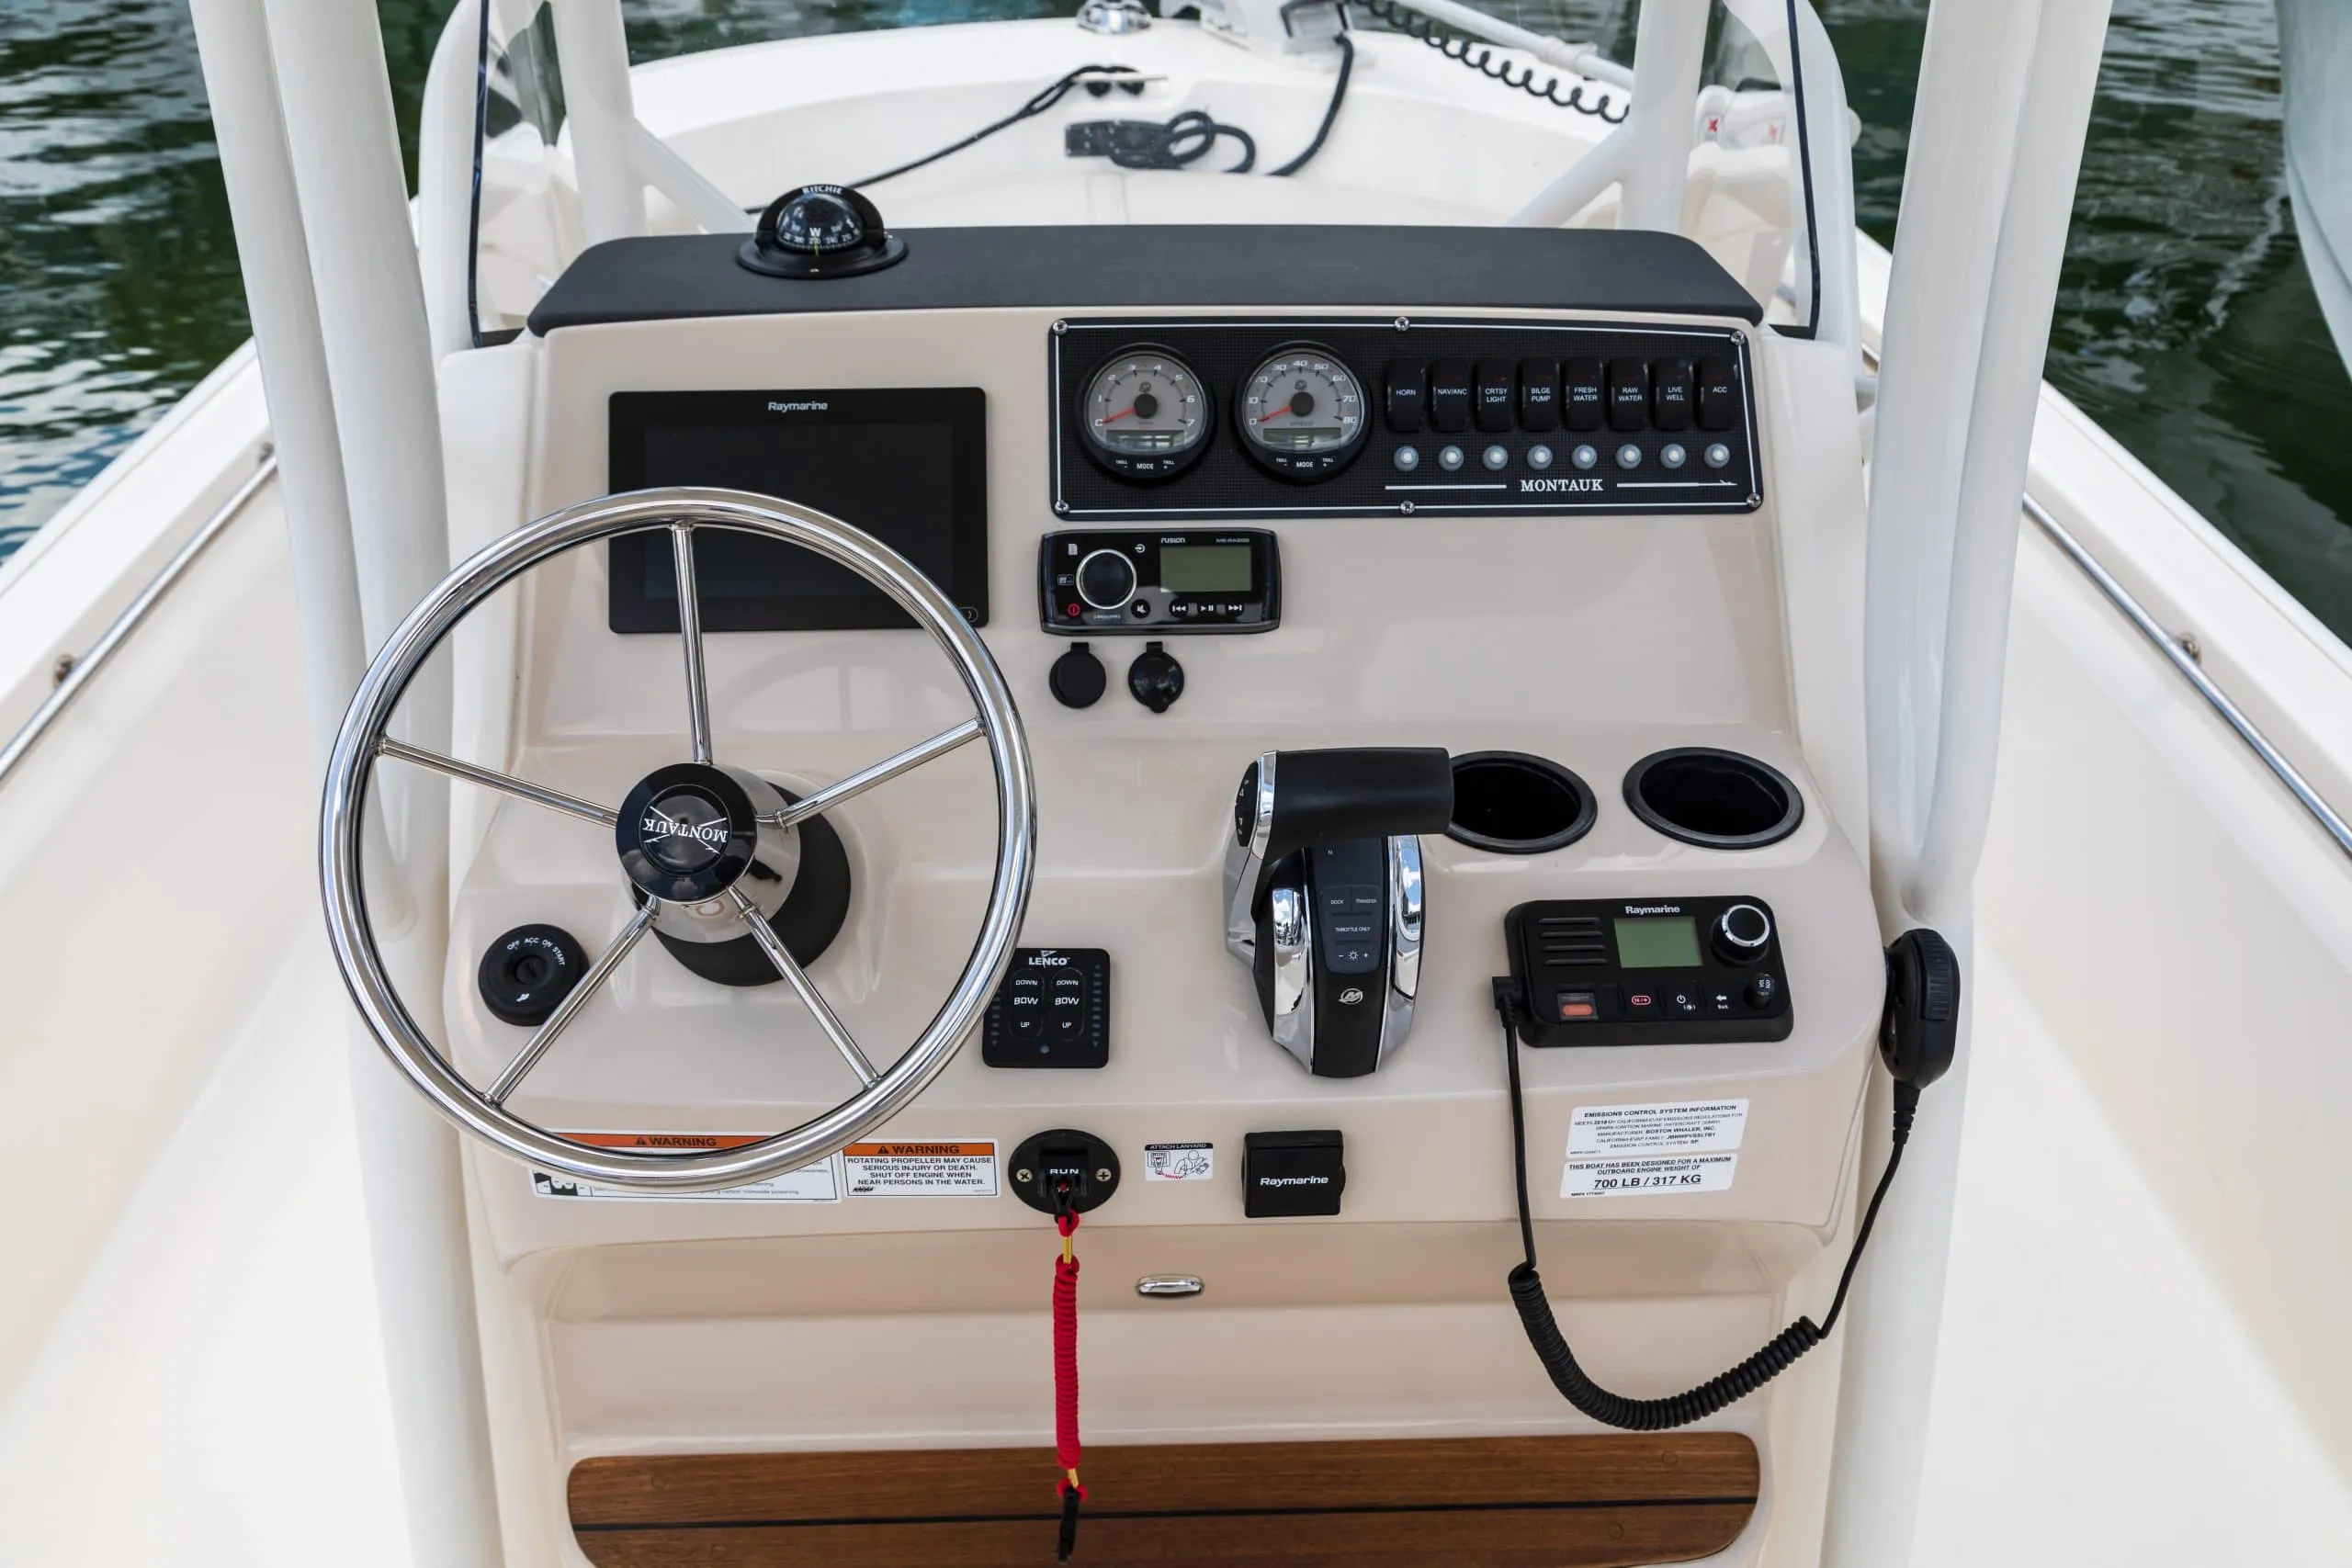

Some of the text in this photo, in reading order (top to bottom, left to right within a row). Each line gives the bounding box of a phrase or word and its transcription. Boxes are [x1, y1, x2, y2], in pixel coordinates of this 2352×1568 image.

[802, 186, 842, 194] RITCHIE
[809, 228, 821, 237] W
[1249, 396, 1259, 404] 10
[768, 401, 828, 412] Raymarine
[1187, 419, 1195, 427] 7
[1343, 416, 1357, 424] 80
[1520, 479, 1604, 492] MONTAUK
[643, 818, 728, 842] MONTAUK
[1625, 905, 1680, 915] Raymarine
[507, 941, 520, 950] OFF
[552, 946, 566, 966] START
[1029, 957, 1067, 966] LENCO
[650, 1136, 717, 1147] WARNING
[892, 1145, 959, 1154] WARNING
[1260, 1176, 1329, 1187] Raymarine
[1595, 1175, 1702, 1188] 700 LB / 317 KG
